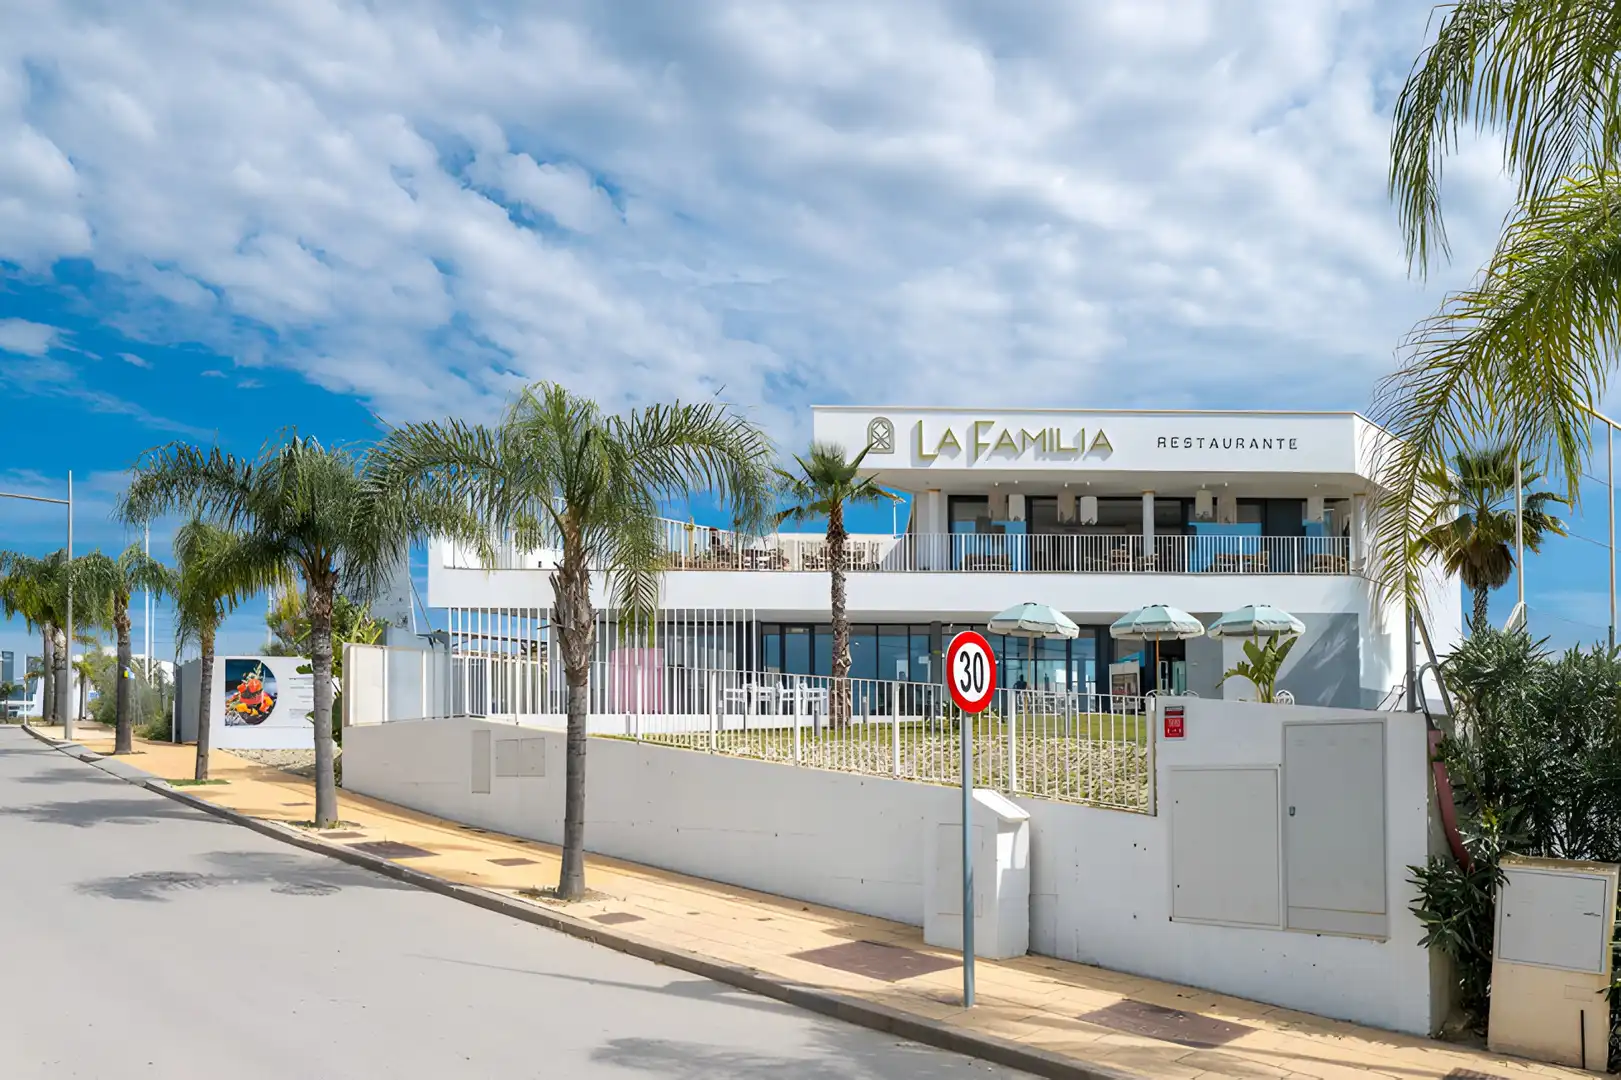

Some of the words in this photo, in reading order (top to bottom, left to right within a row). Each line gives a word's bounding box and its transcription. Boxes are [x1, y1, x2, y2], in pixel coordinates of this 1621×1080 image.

[974, 420, 1114, 462] FAMILIA
[1157, 436, 1299, 450] RESTAURANTE
[959, 650, 985, 694] 30
